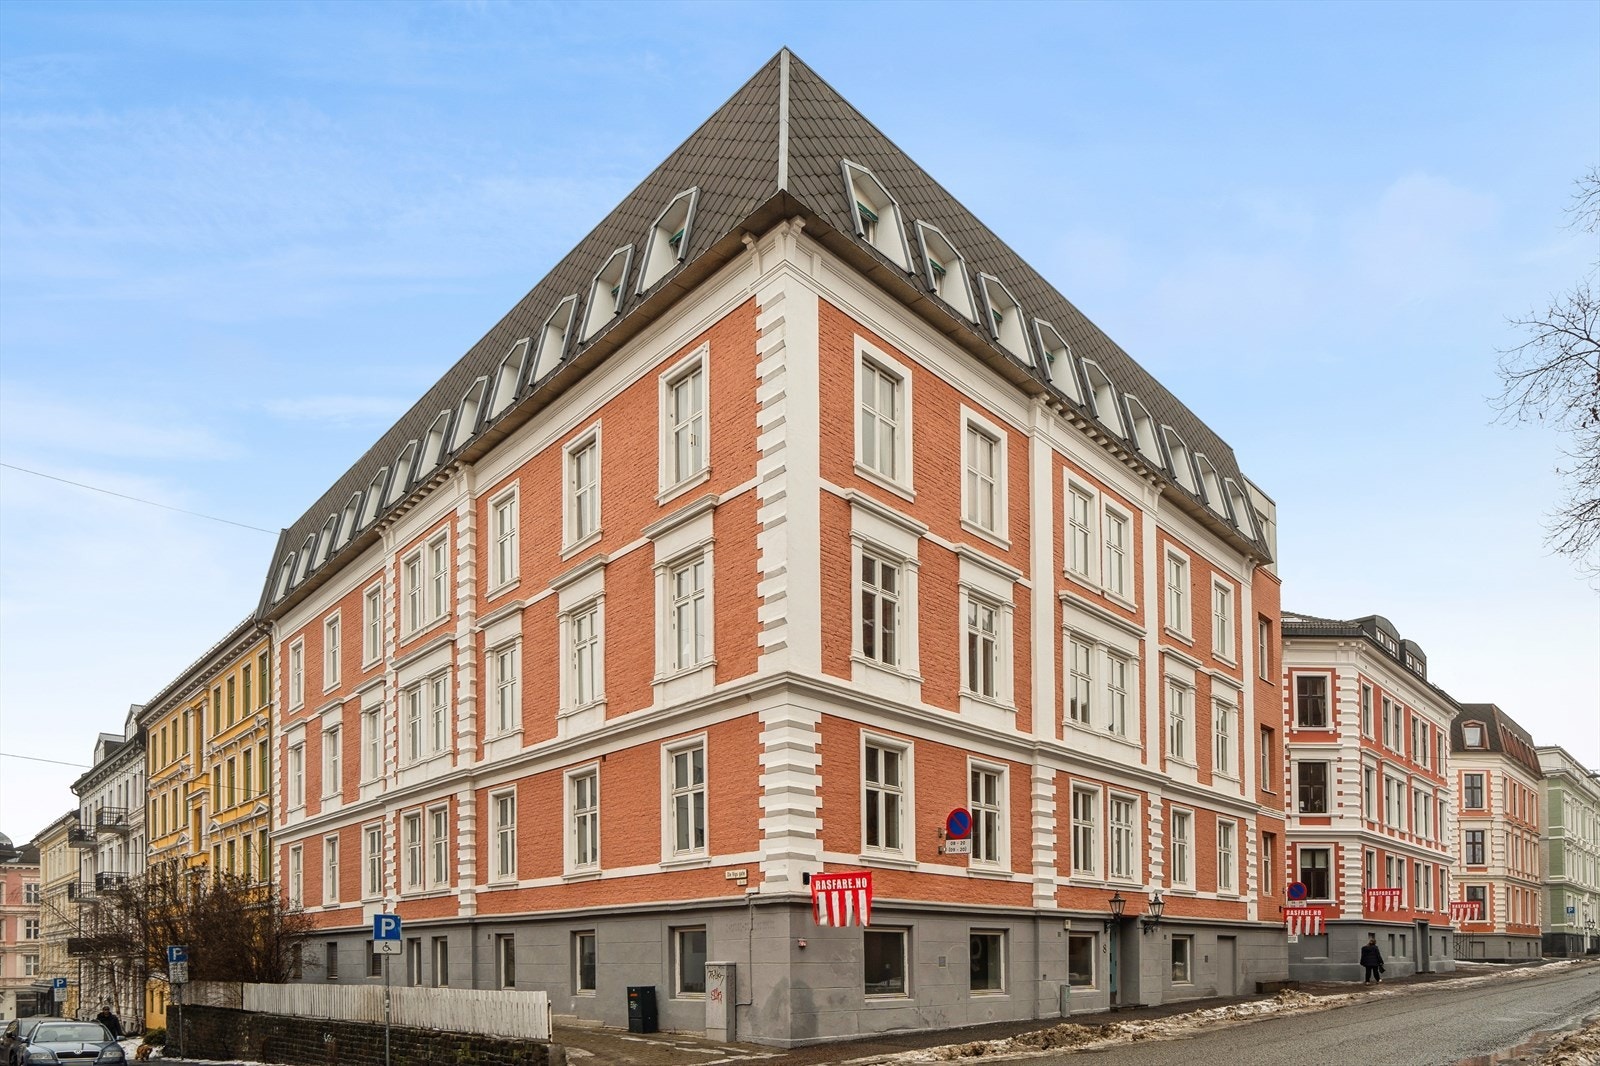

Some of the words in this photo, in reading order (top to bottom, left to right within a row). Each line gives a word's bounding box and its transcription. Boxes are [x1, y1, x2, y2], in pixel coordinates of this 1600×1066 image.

[815, 877, 868, 890] RASFARE.NO
[381, 918, 396, 937] P
[173, 947, 182, 960] P
[1103, 943, 1107, 954] 8
[56, 979, 64, 988] P
